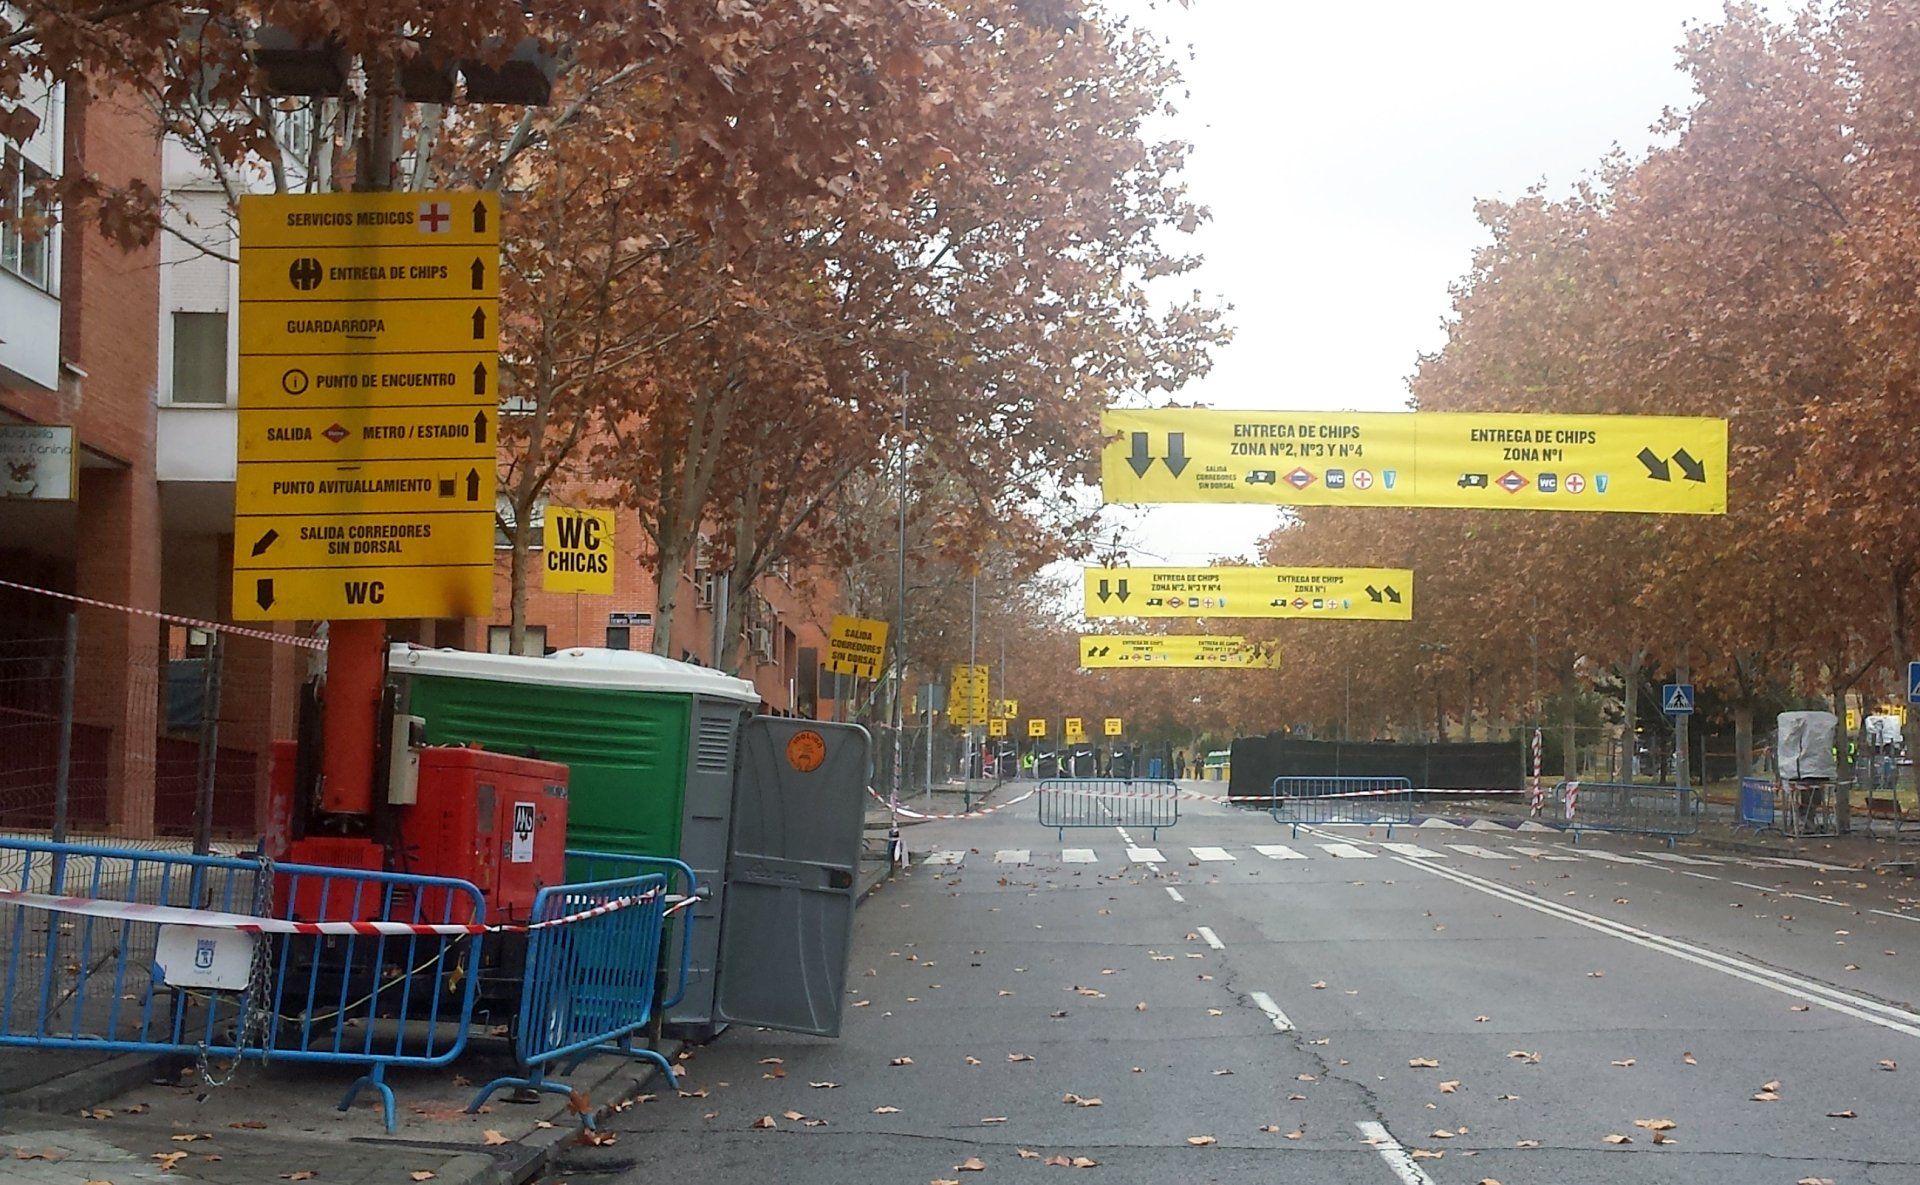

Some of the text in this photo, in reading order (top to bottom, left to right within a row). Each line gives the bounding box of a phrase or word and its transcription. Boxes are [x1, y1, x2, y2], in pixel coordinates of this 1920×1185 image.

[287, 212, 414, 226] SERVICIOS MEDICOS
[330, 266, 448, 280] ENTREGA DE CHIPS
[287, 320, 385, 334] GUARDARROPA
[316, 373, 456, 388] PUNTO DE ENCUENTRO
[267, 427, 312, 441] SALIDA
[363, 426, 406, 440] METRO
[418, 424, 469, 438] ESTADIO
[1234, 424, 1360, 439] ENTREGA DE CHIPS
[1471, 429, 1596, 444] ENTREGA DE CHIPS
[1230, 442, 1266, 456] ZONA
[1327, 444, 1336, 456] Y
[1504, 448, 1539, 461] ZONA
[273, 479, 432, 495] PUNTO AVITUALLAMIENTO
[300, 524, 431, 540] SALIDA CORREDORES
[557, 516, 600, 550] WC
[328, 540, 402, 555] SIN DORSAL
[548, 550, 608, 574] CHICAS
[345, 581, 384, 604] WC
[844, 628, 872, 640] SALIDA
